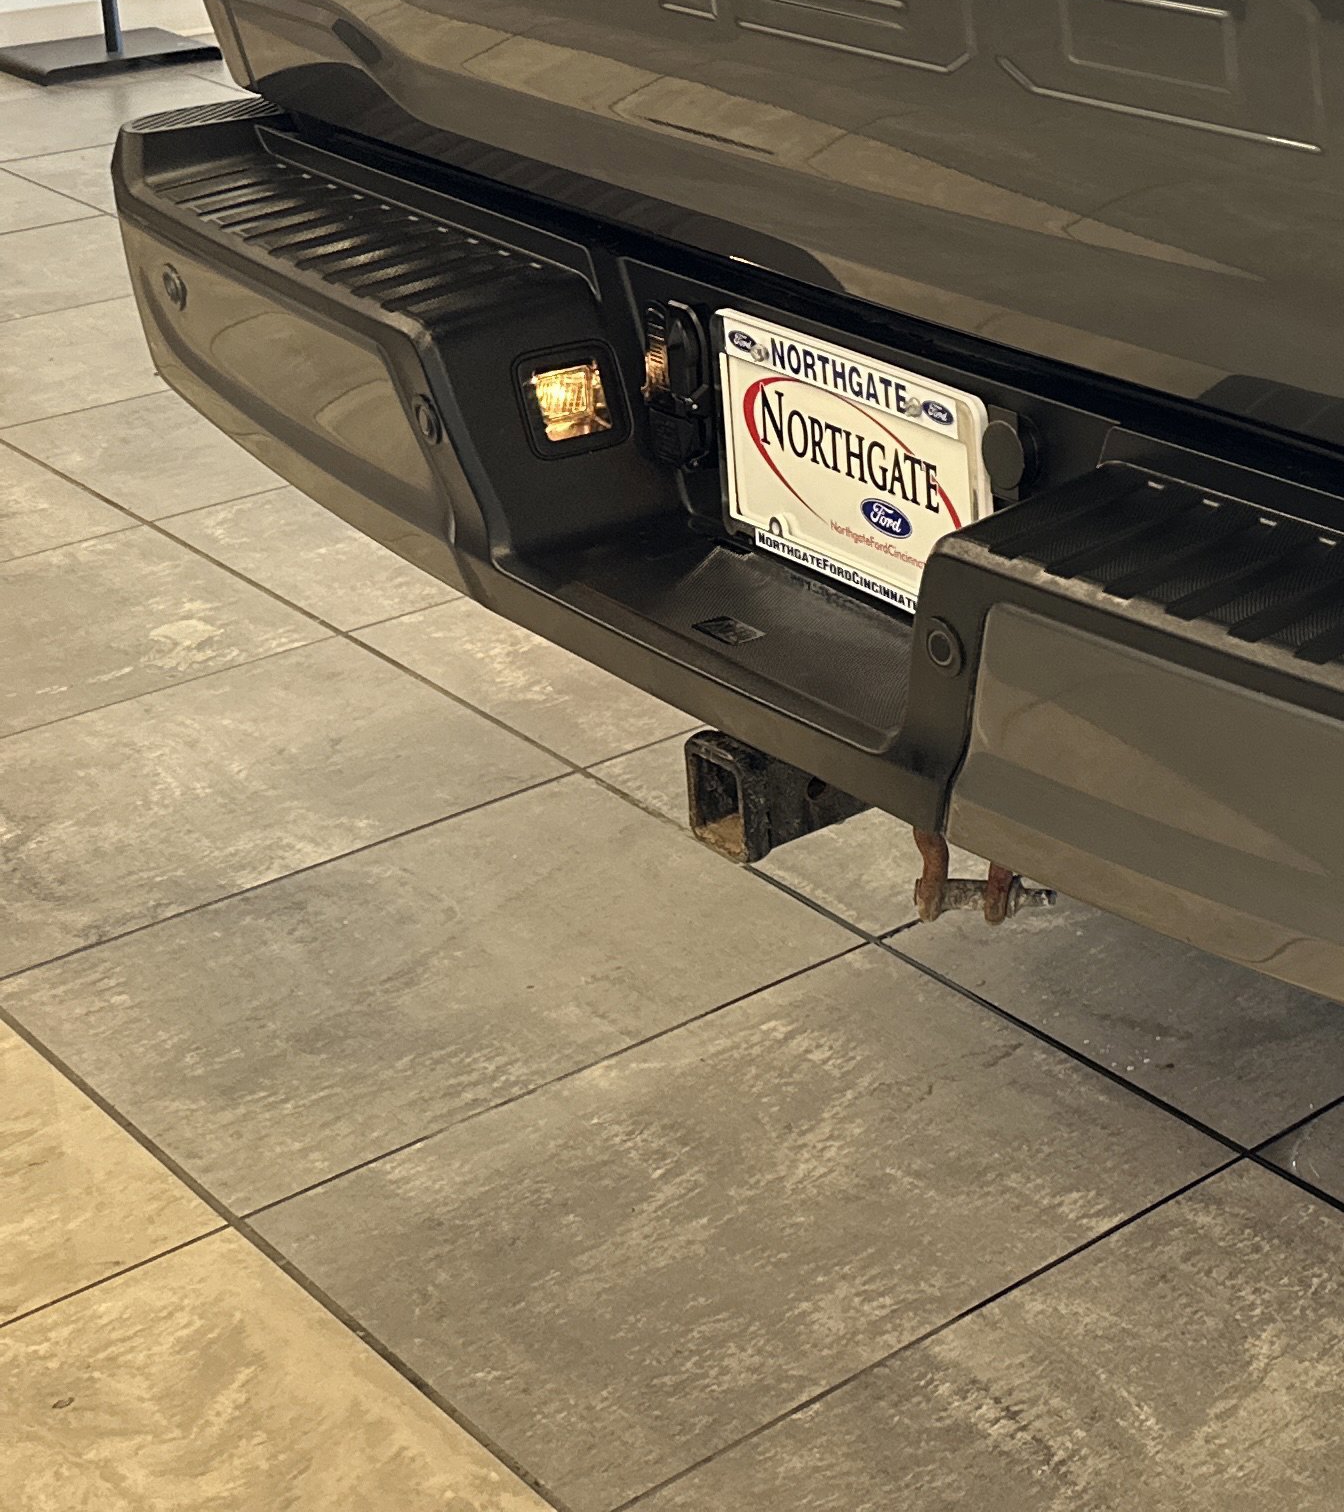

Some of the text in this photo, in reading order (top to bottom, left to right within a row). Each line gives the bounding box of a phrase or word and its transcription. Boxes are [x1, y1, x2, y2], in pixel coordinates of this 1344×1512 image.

[770, 337, 907, 415] NORTHGATE
[759, 383, 940, 515] NORTHGATE
[869, 501, 902, 533] Ford
